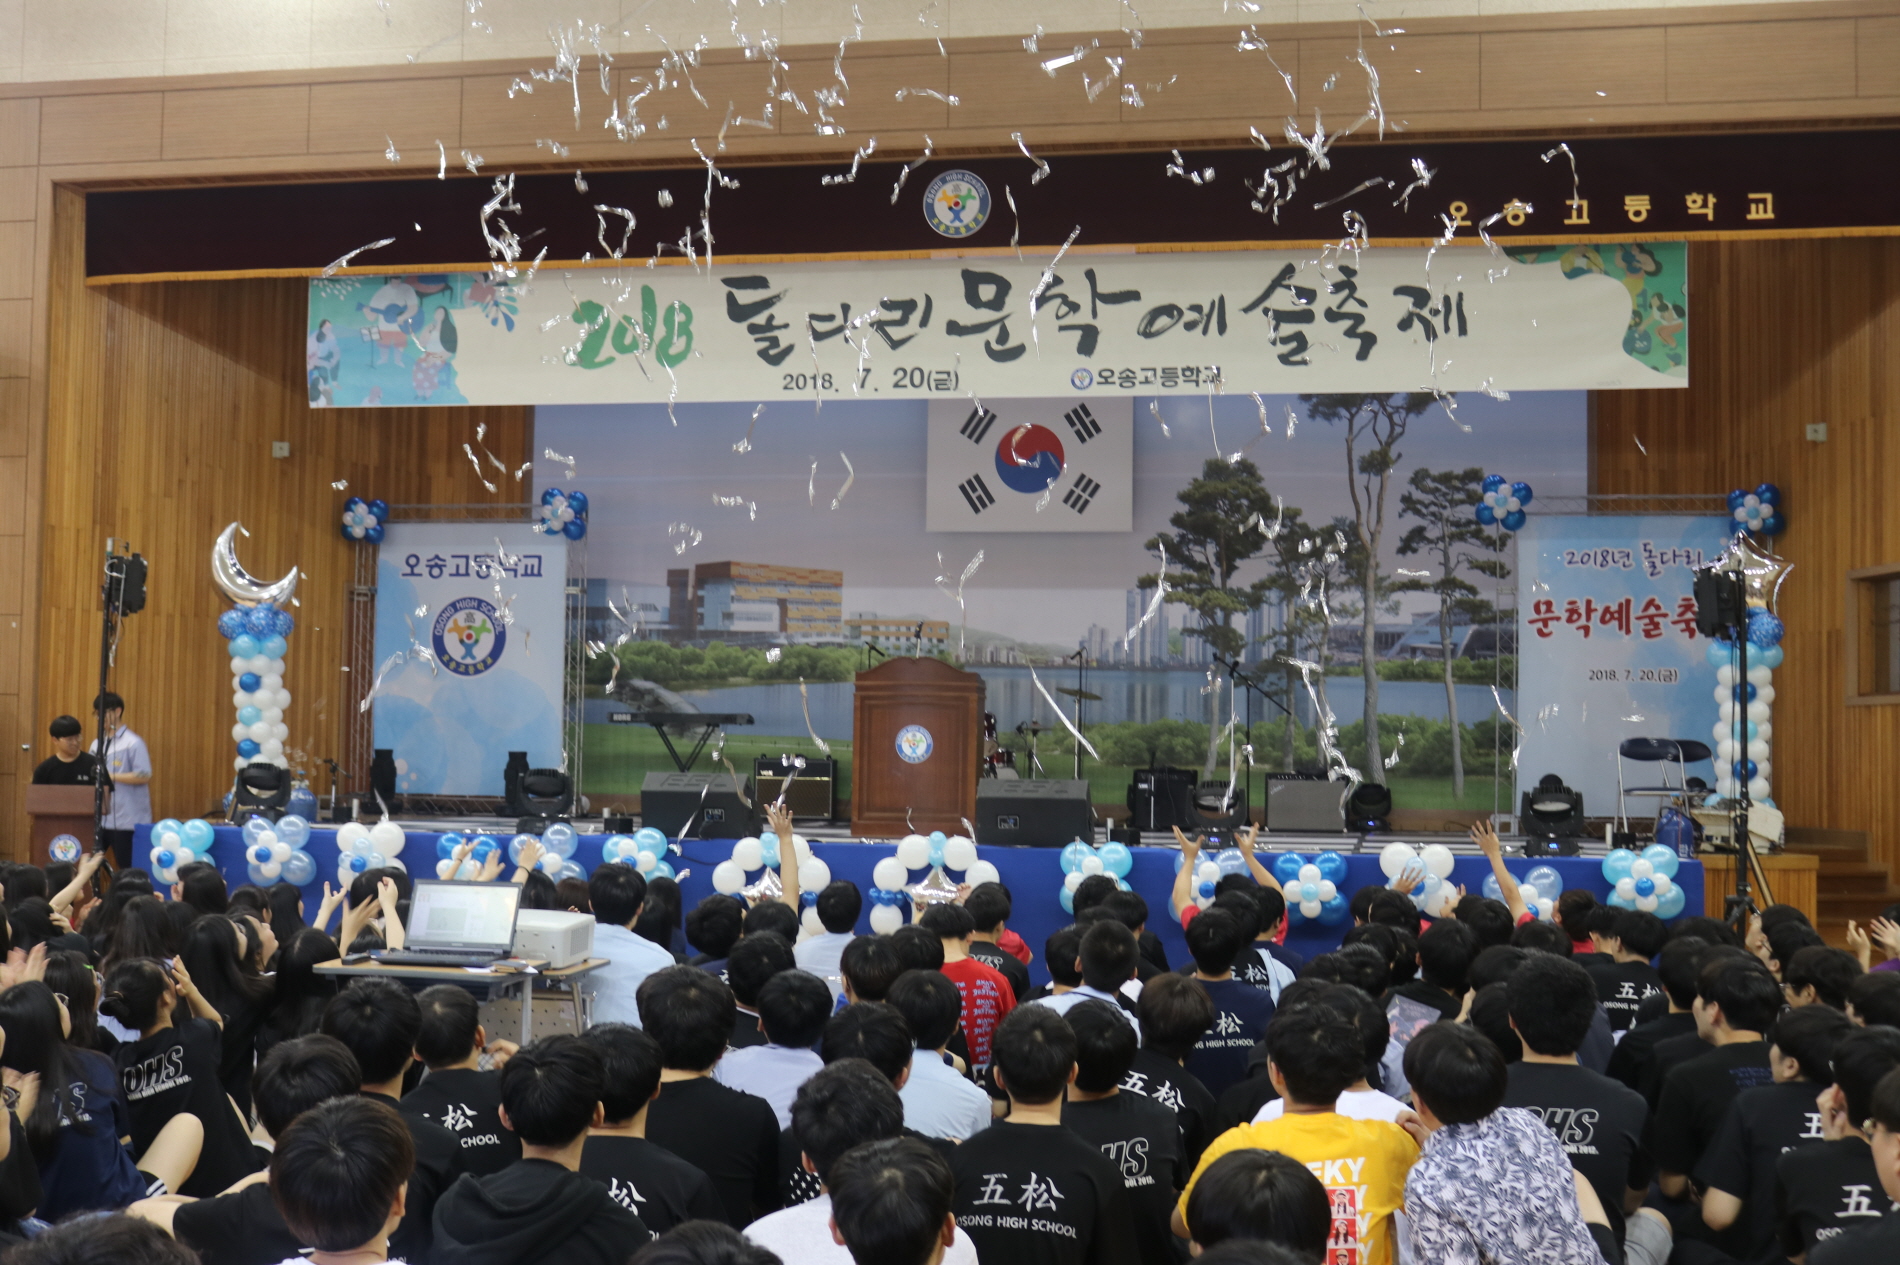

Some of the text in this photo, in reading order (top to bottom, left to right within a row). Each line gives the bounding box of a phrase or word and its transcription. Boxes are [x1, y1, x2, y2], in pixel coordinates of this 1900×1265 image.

[564, 284, 693, 370] 2018
[892, 367, 959, 391] 20(금)
[1096, 365, 1221, 389] 오송고등학교
[1565, 541, 1701, 577] 2018년 돌다리
[1528, 597, 1696, 639] 문학예술축
[1589, 670, 1619, 681] 2018.
[1205, 1010, 1244, 1037] 松
[123, 1045, 183, 1095] OHS
[423, 1103, 478, 1131] 松
[460, 1134, 500, 1148] CHOOL
[997, 1215, 1028, 1229] HIGH
[1031, 1218, 1078, 1239] SCHOOL
